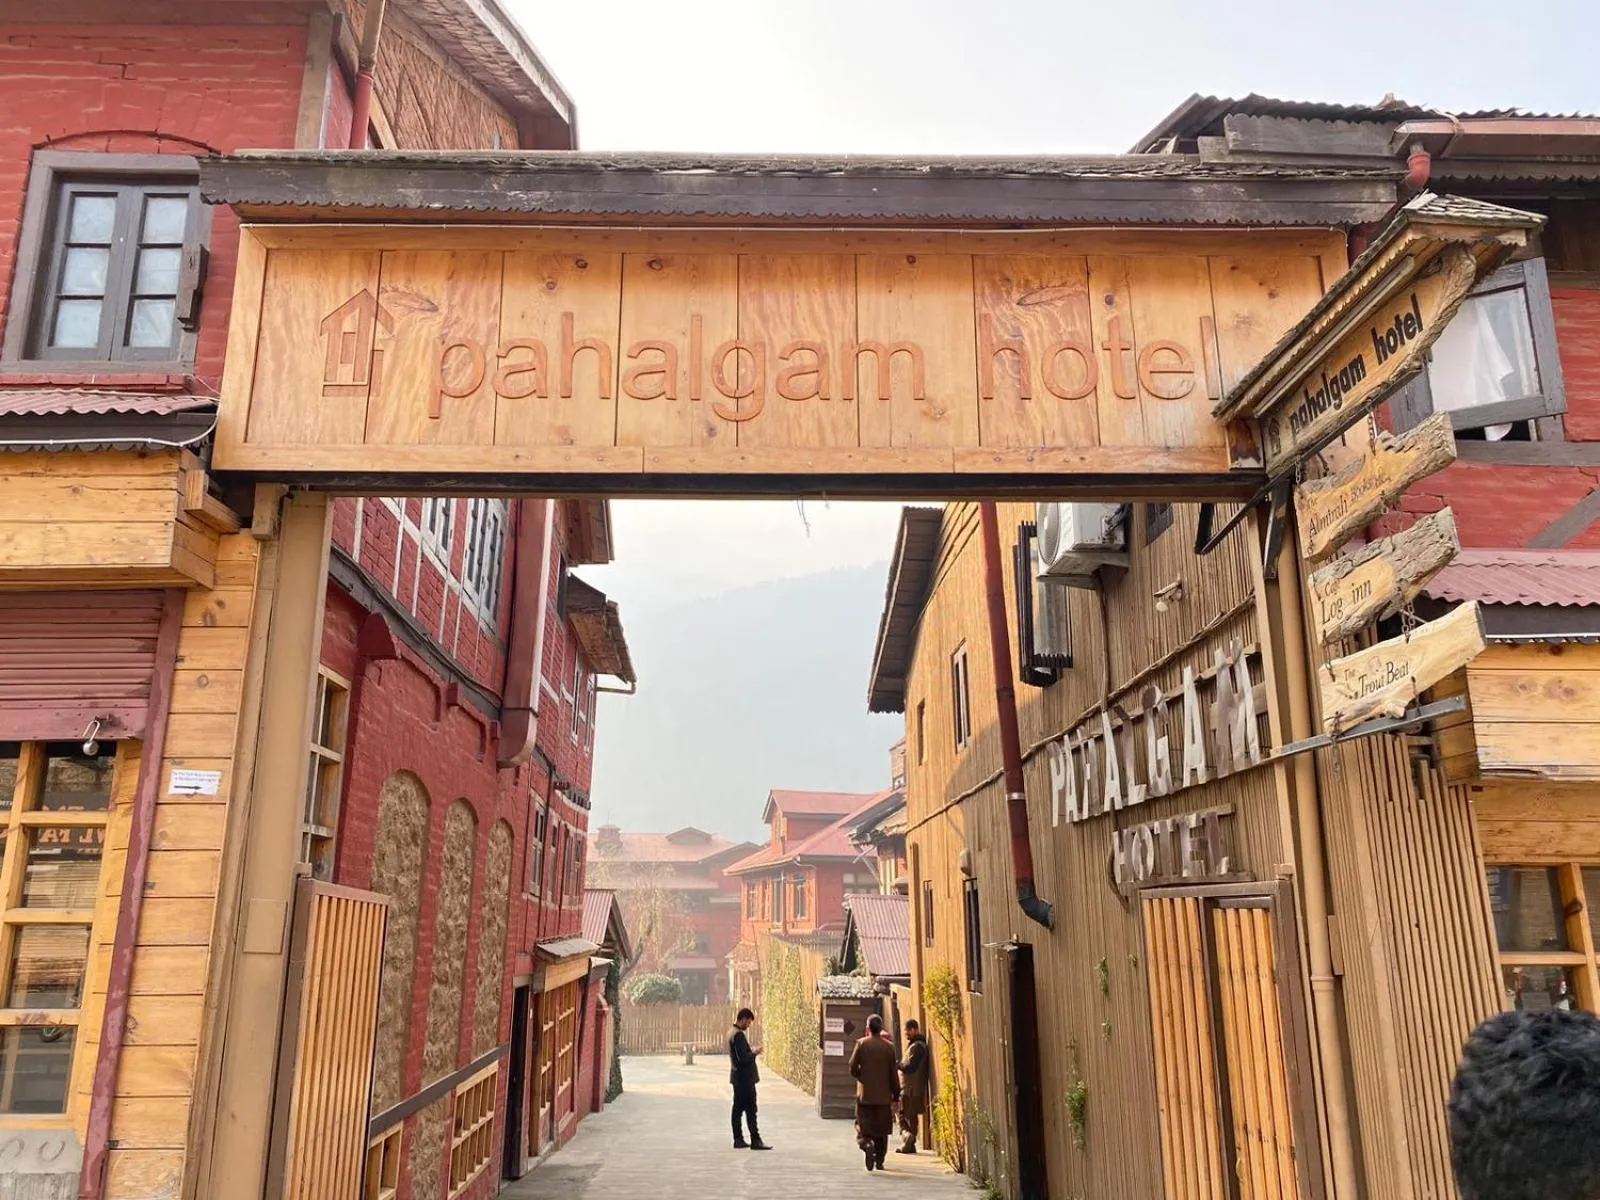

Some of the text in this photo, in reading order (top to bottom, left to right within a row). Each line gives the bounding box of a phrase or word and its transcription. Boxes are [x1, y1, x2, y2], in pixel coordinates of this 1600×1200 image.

[429, 312, 1221, 422] pahalgam hotel
[1289, 293, 1424, 440] pahalgam hotel
[1321, 579, 1372, 624] Log inn
[1358, 660, 1409, 698] Trout Beat
[1113, 811, 1230, 883] HOTEL
